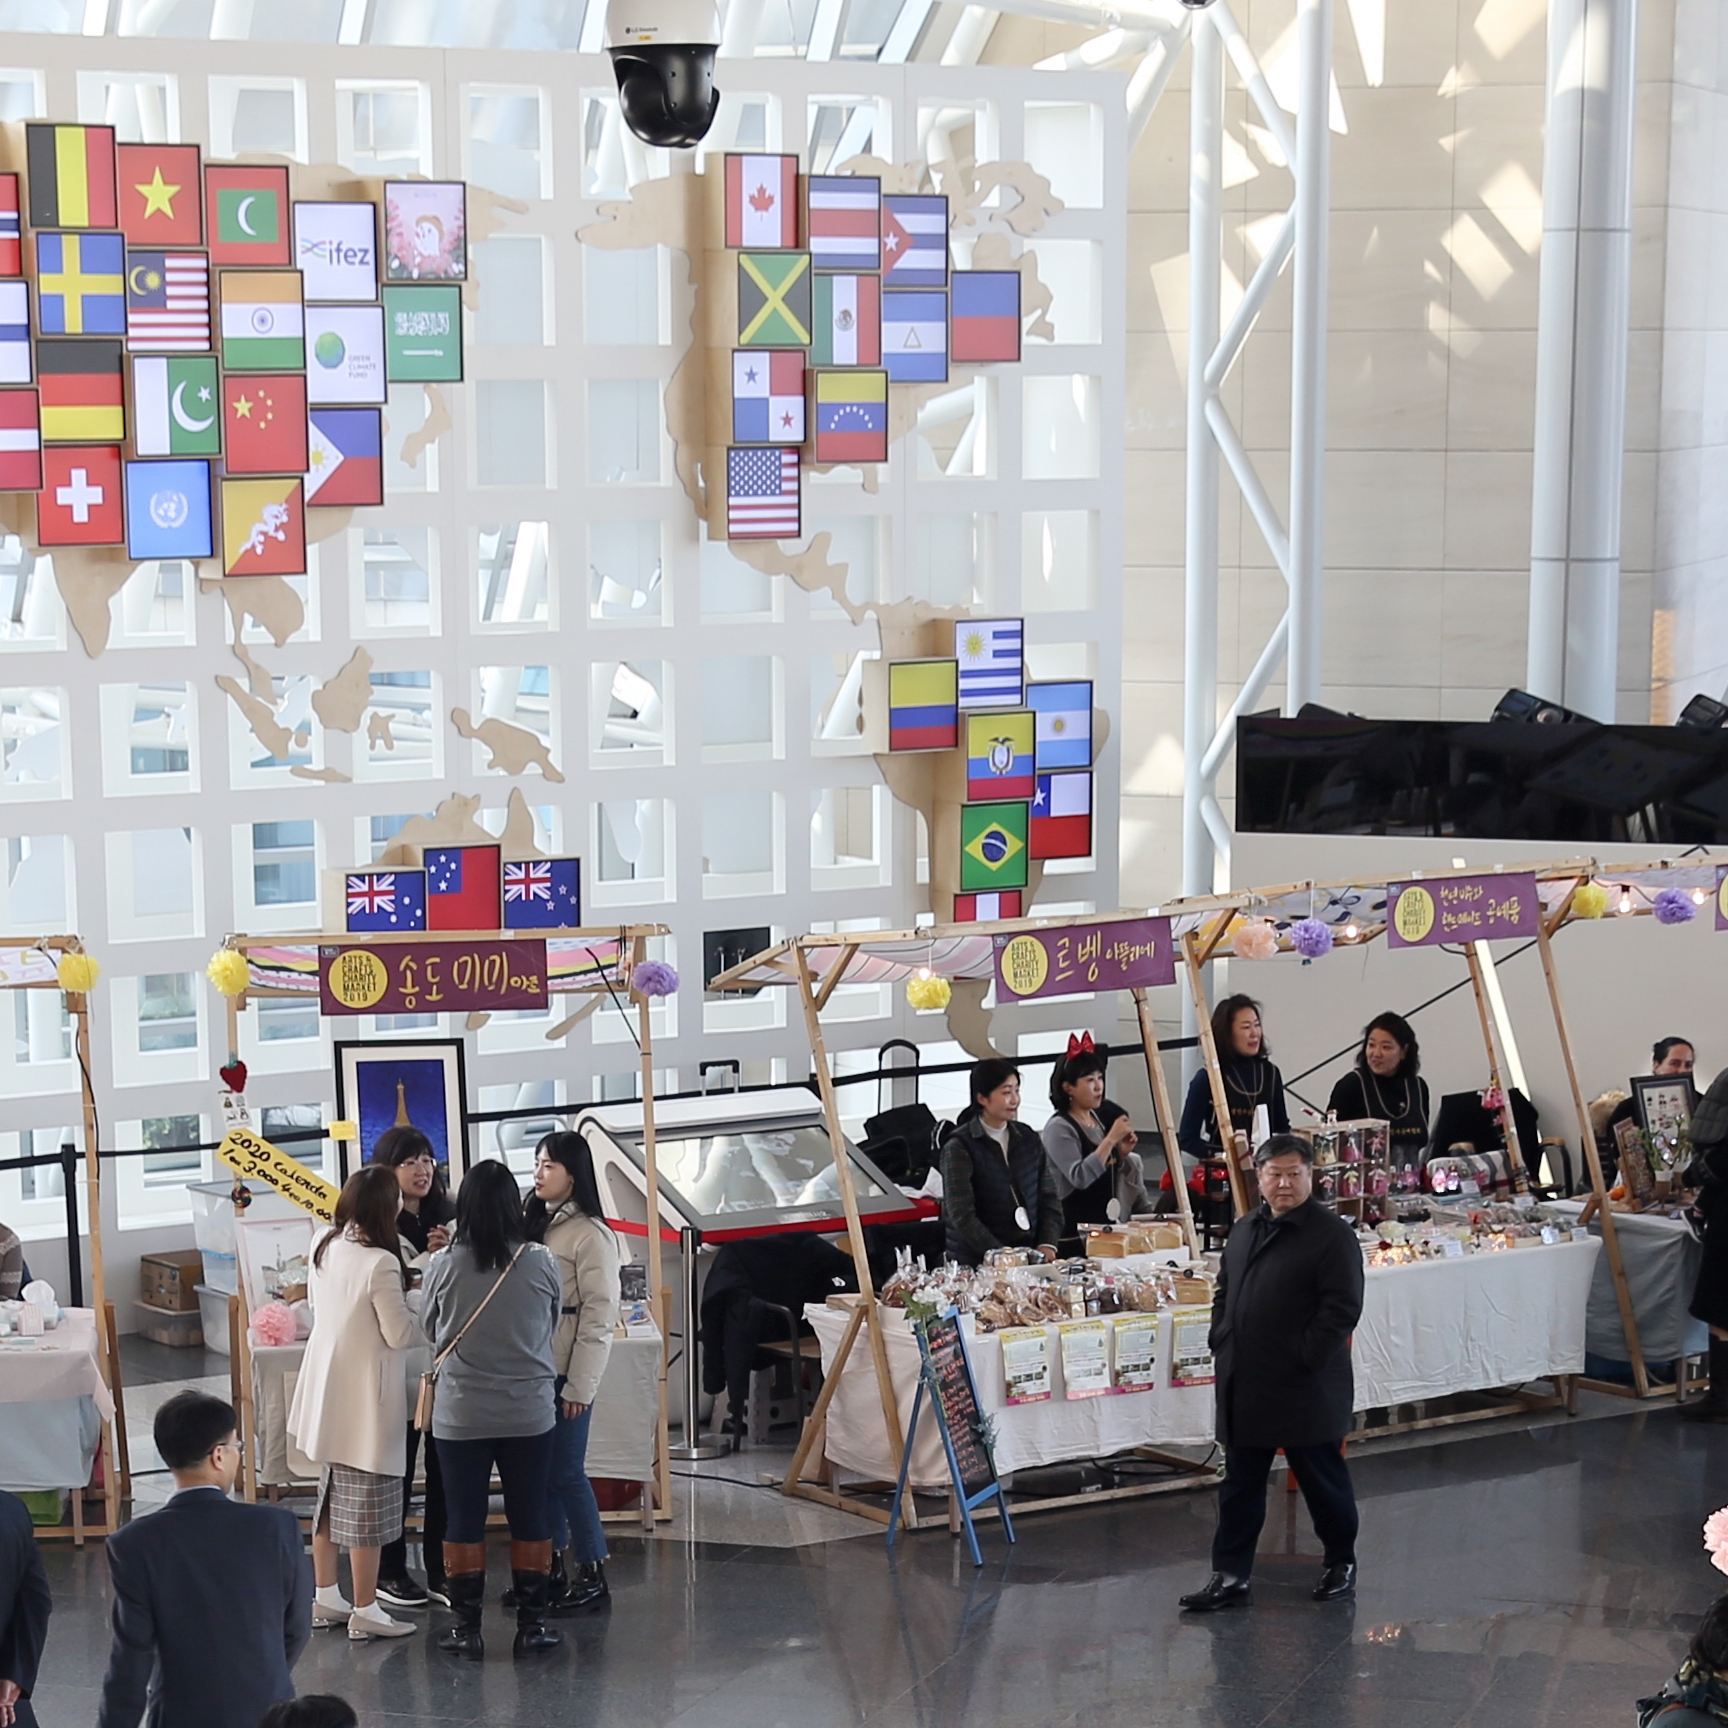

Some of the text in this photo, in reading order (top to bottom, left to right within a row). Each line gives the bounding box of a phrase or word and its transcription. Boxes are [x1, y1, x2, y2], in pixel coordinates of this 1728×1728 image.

[328, 240, 370, 266] ifez
[348, 355, 371, 363] GREEN
[342, 955, 363, 966] ARTS
[1055, 930, 1103, 983] 르벵
[342, 963, 374, 975] CRAFTS
[1013, 968, 1040, 979] MARKET
[342, 974, 377, 984] CHARITY
[398, 955, 444, 1009] 송도
[1013, 979, 1033, 989] 2019
[343, 983, 377, 993] MARKET
[343, 992, 368, 1002] 2019
[229, 1132, 271, 1162] 2020
